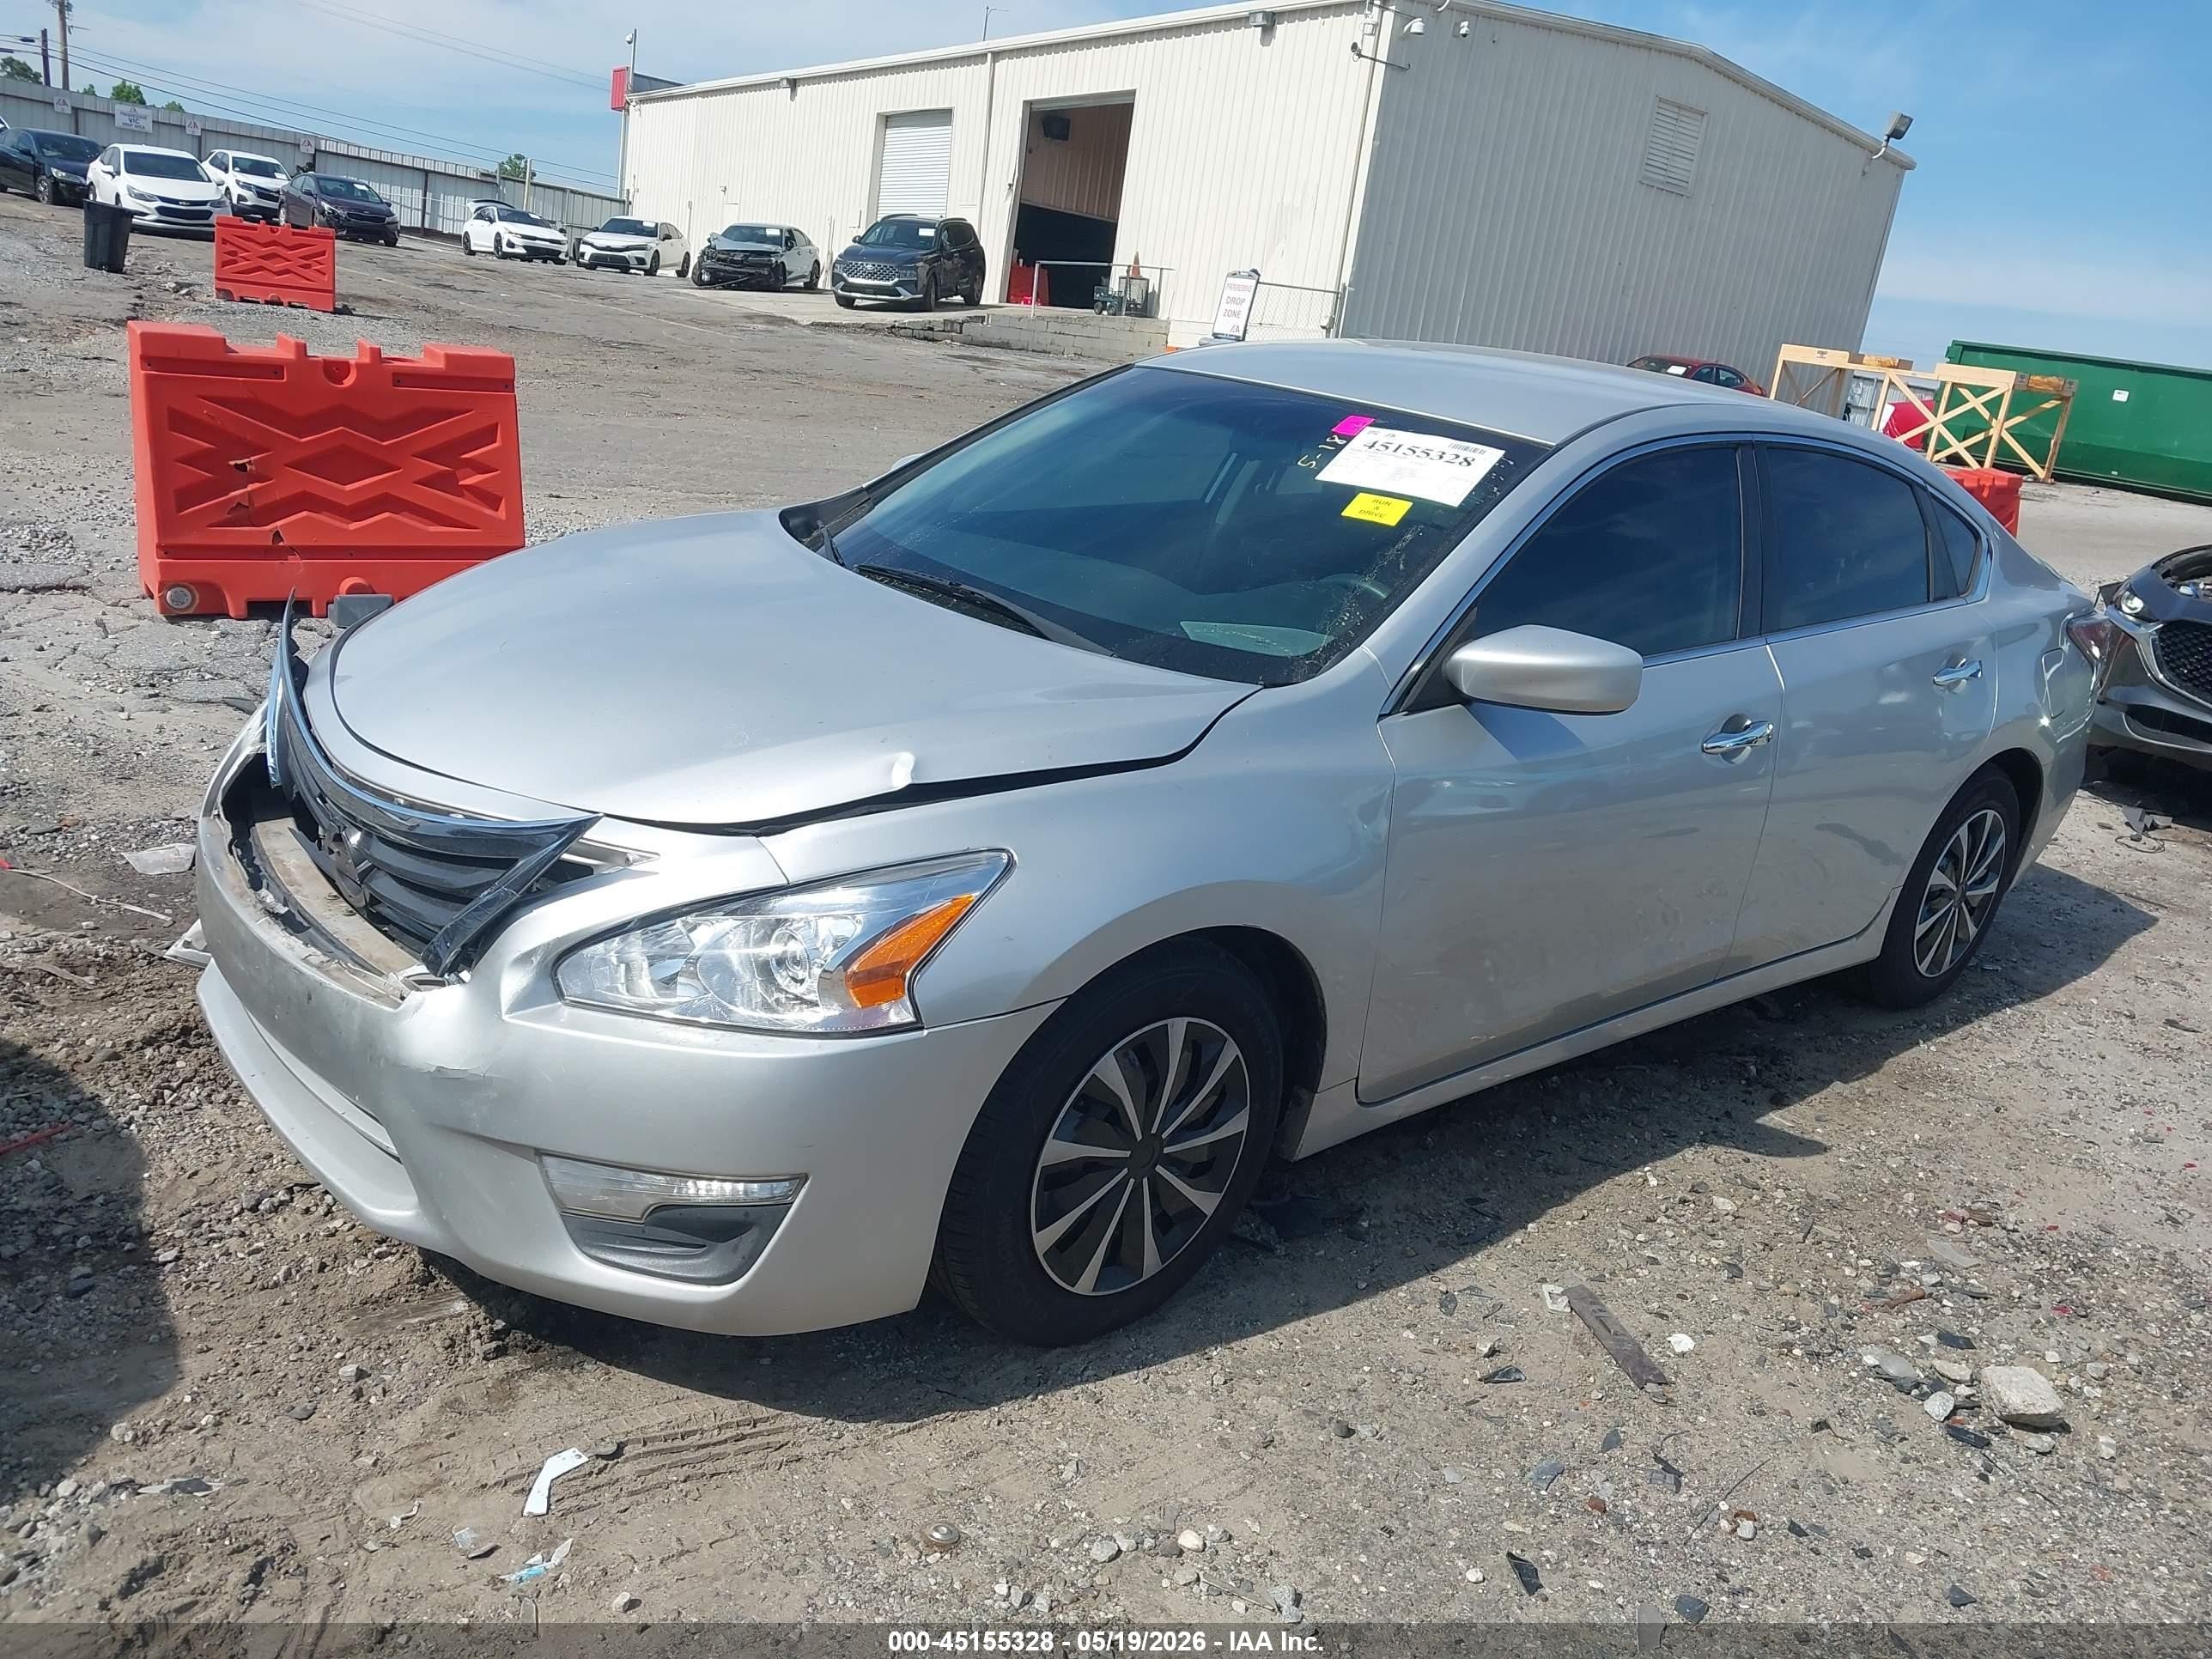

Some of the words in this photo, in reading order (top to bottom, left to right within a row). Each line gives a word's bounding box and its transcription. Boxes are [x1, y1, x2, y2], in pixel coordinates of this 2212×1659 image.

[1225, 295, 1246, 307] DROP
[1223, 308, 1243, 319] ZONE
[1363, 440, 1476, 467] 45155328
[1358, 509, 1388, 519] DRIVE
